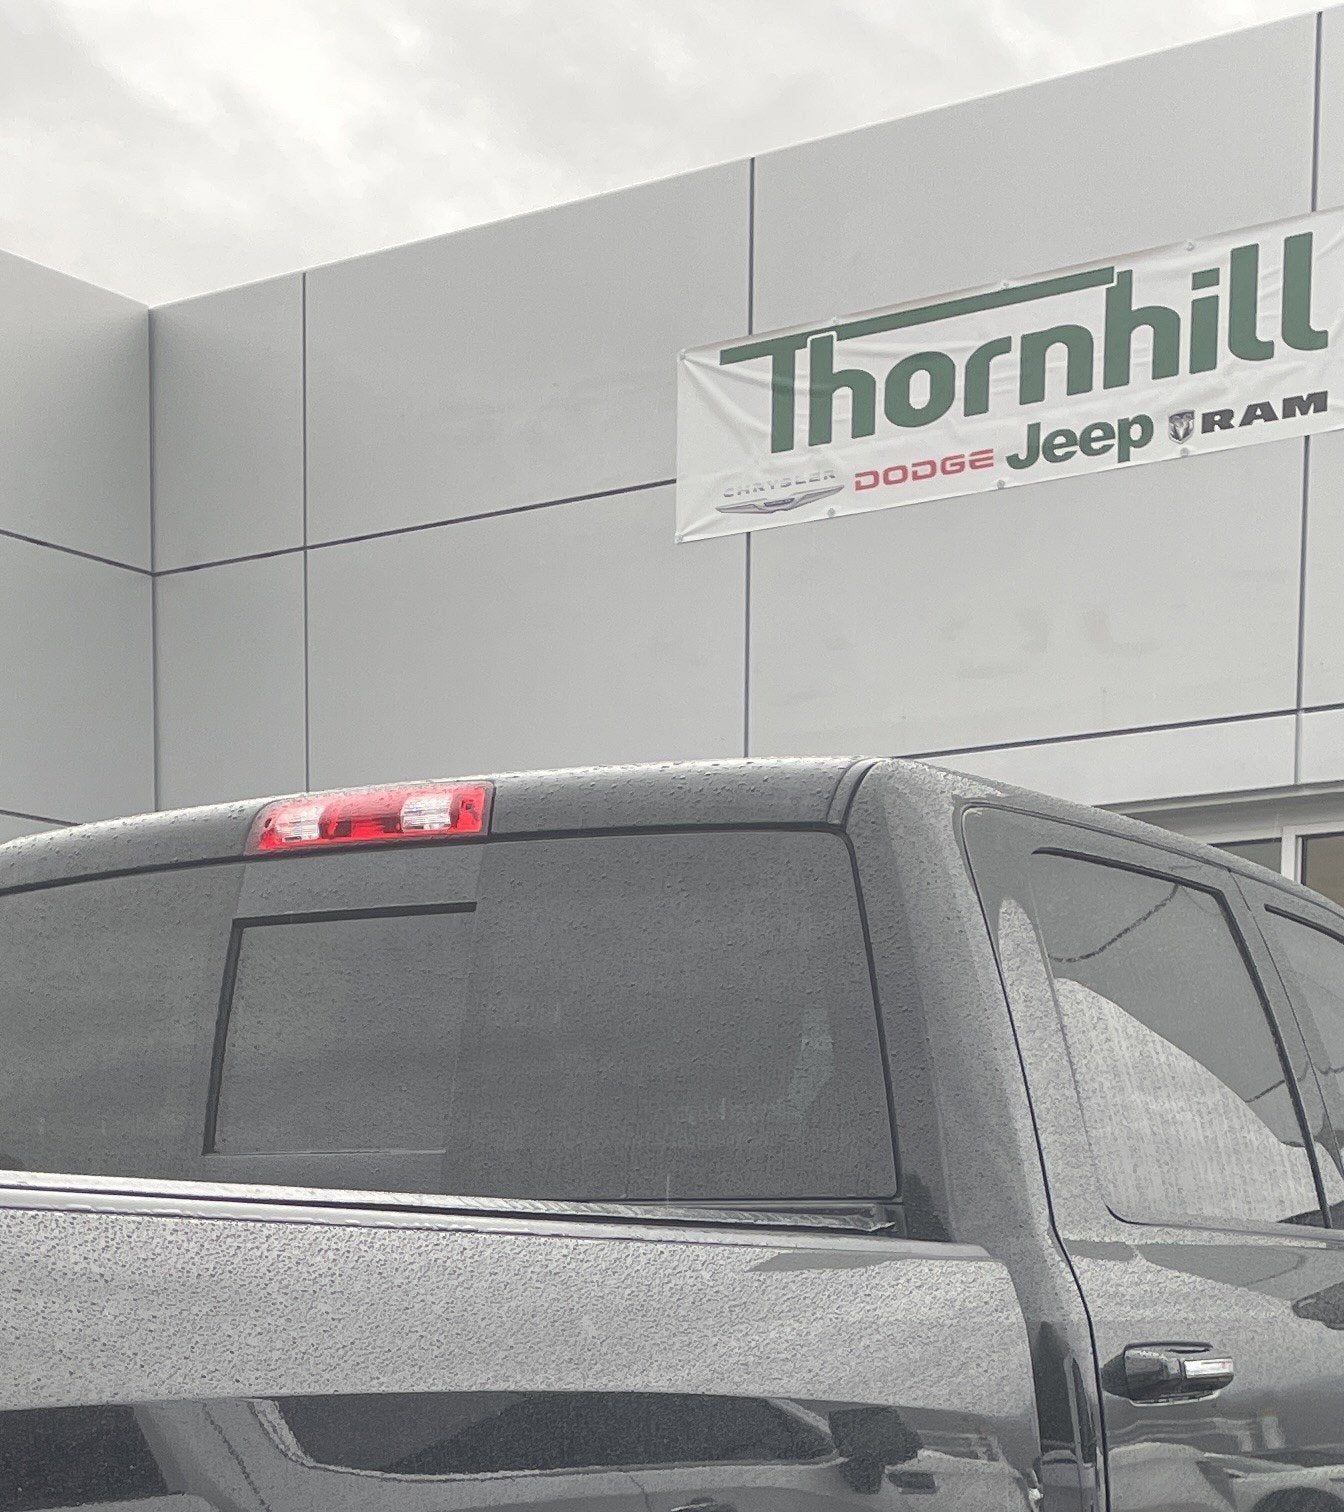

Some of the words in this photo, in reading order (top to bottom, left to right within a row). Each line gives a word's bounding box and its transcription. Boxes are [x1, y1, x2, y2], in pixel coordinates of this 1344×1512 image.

[719, 231, 1329, 454] Thornhill
[854, 448, 994, 491] DODGE
[1005, 413, 1154, 470] Jeep
[1201, 390, 1328, 434] RAM
